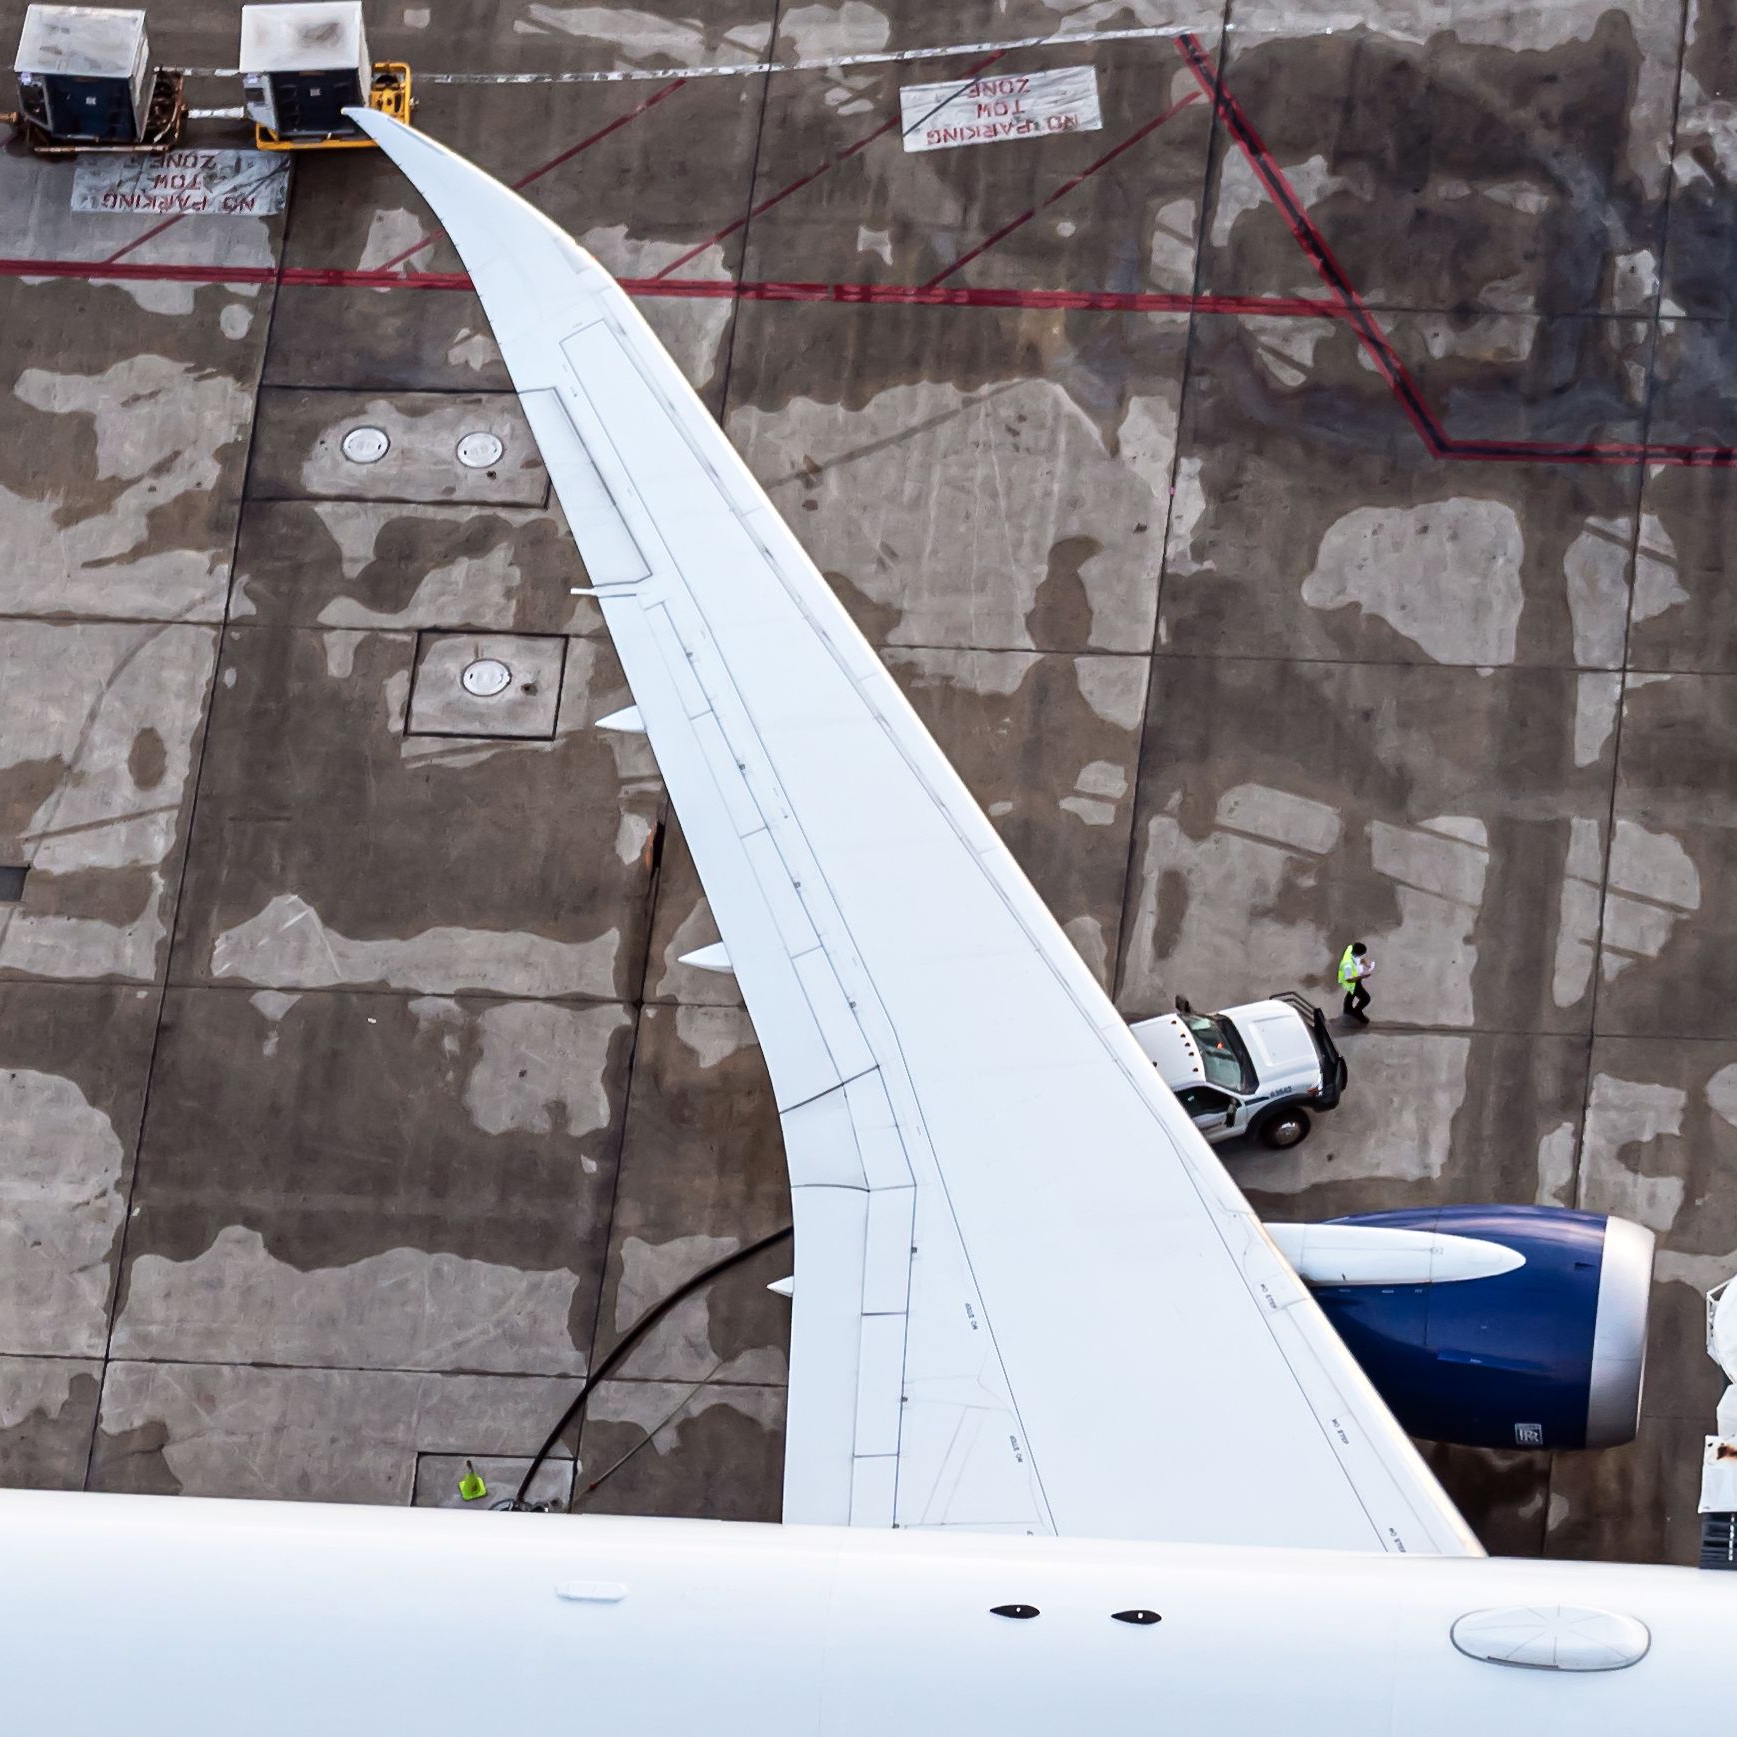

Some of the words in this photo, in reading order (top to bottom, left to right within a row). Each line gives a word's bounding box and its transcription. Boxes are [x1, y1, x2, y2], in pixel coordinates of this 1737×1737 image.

[967, 78, 1032, 99] ZONE
[976, 99, 1026, 118] TOW
[1046, 114, 1079, 132] NO
[925, 119, 1036, 146] PARKING
[149, 153, 218, 170] ZONE
[153, 173, 203, 191] TOW
[101, 192, 208, 213] PARKING
[221, 196, 257, 214] NO
